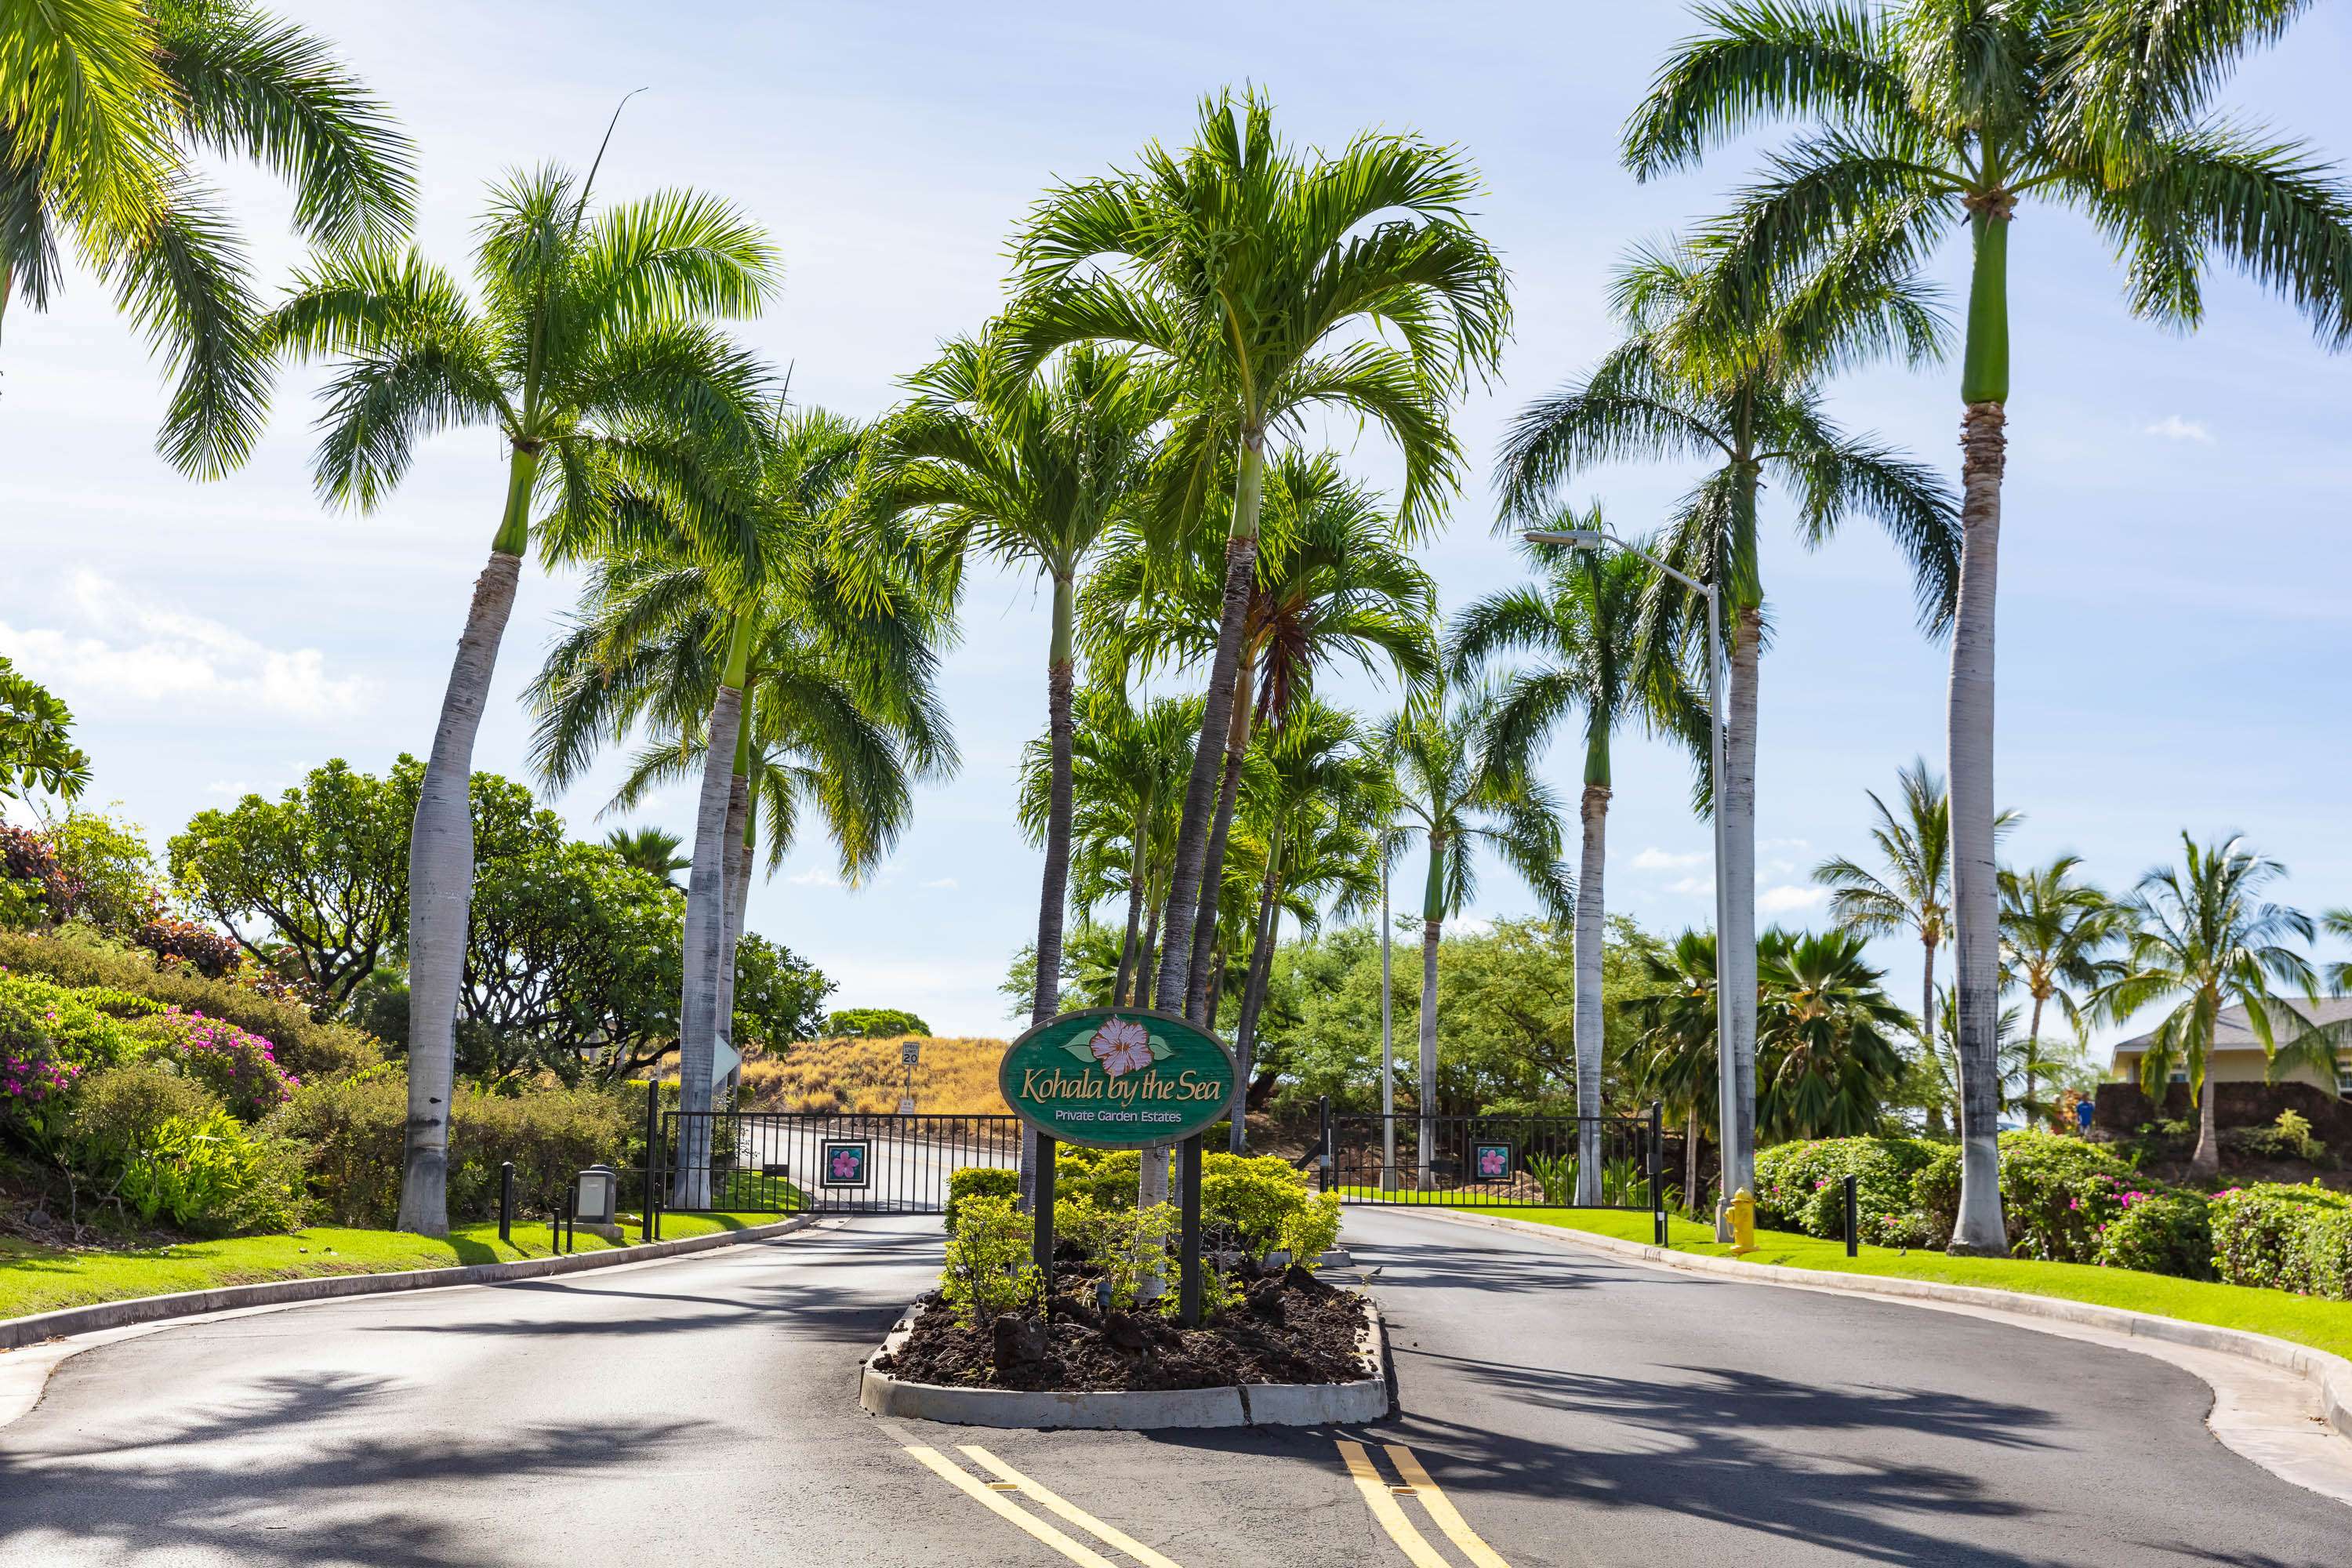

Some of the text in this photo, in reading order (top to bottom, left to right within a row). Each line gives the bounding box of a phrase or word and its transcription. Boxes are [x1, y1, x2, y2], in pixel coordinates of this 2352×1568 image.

[904, 1054, 917, 1062] 20
[1019, 1067, 1221, 1107] Kohala by the Sea
[1055, 1110, 1181, 1123] Private Garden Estates
